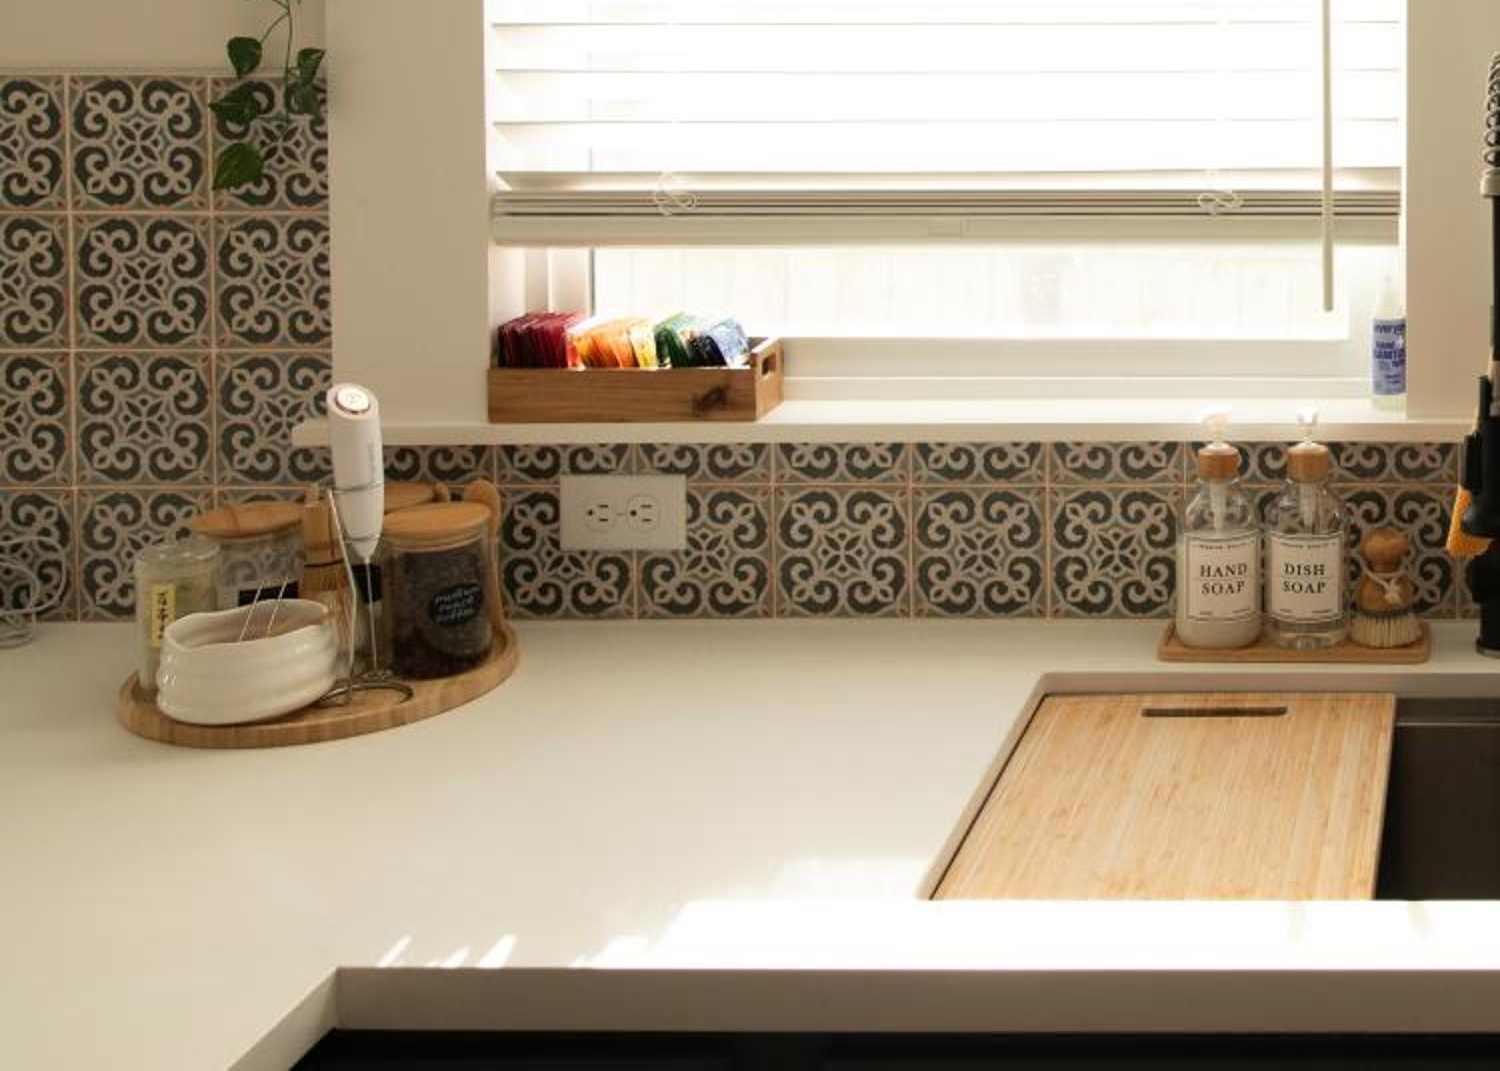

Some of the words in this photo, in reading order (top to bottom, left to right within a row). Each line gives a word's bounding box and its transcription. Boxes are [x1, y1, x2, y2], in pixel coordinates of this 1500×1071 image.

[1200, 563, 1247, 577] HAND
[1284, 563, 1325, 576] DISH
[1201, 580, 1245, 595] SOAP
[1283, 581, 1326, 594] SOAP
